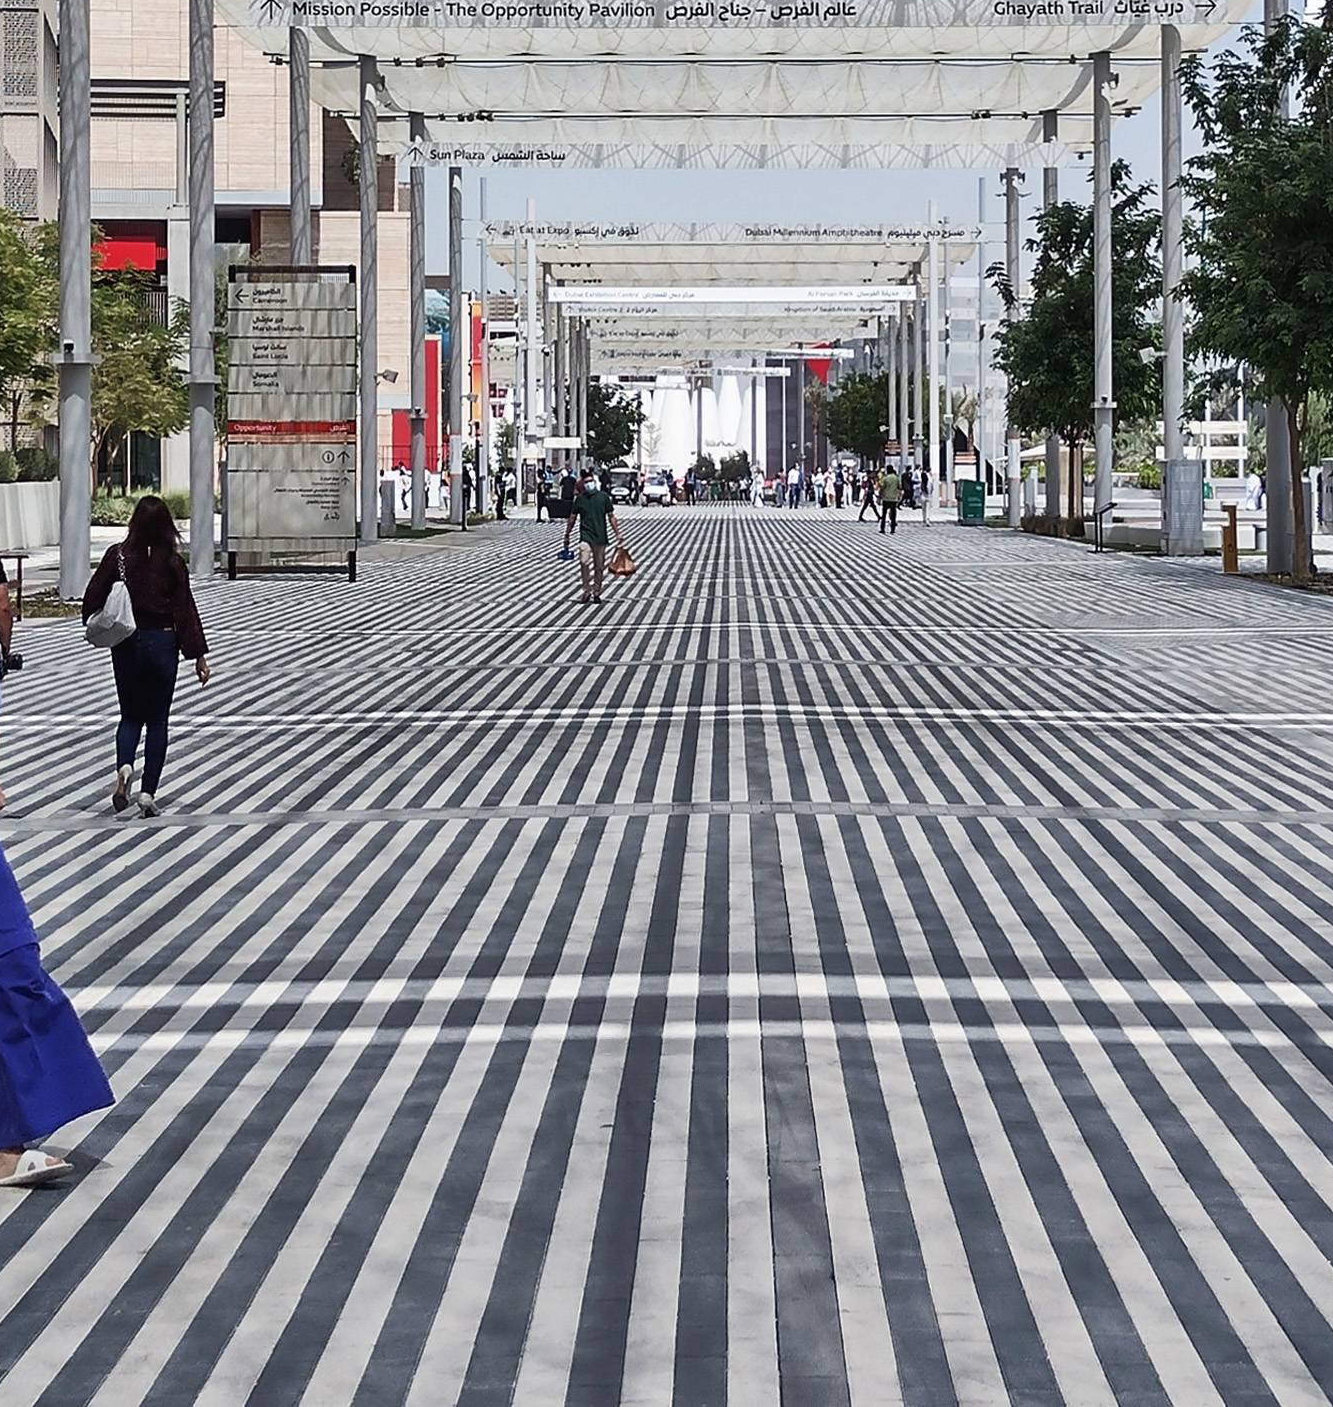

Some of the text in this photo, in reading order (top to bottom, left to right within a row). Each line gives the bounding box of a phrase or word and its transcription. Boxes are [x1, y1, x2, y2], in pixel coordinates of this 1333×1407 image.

[292, 1, 358, 17] Mission
[360, 1, 430, 18] Possible
[446, 2, 477, 18] The
[481, 1, 585, 22] Opportunity
[588, 1, 656, 18] Pavilion
[665, 2, 715, 21] الفرص
[718, 4, 752, 21] جناح
[770, 2, 819, 20] الفرص
[823, 2, 857, 19] عالم
[994, 0, 1105, 20] Ghayath Trail
[1155, 2, 1185, 18] درب
[430, 150, 485, 160] Sun Plaza
[492, 150, 566, 162] ساحة الشمس
[519, 225, 570, 236] Eat at Expo
[745, 228, 771, 236] Dubai
[773, 228, 820, 236] Millennium
[234, 425, 277, 433] Opportunity
